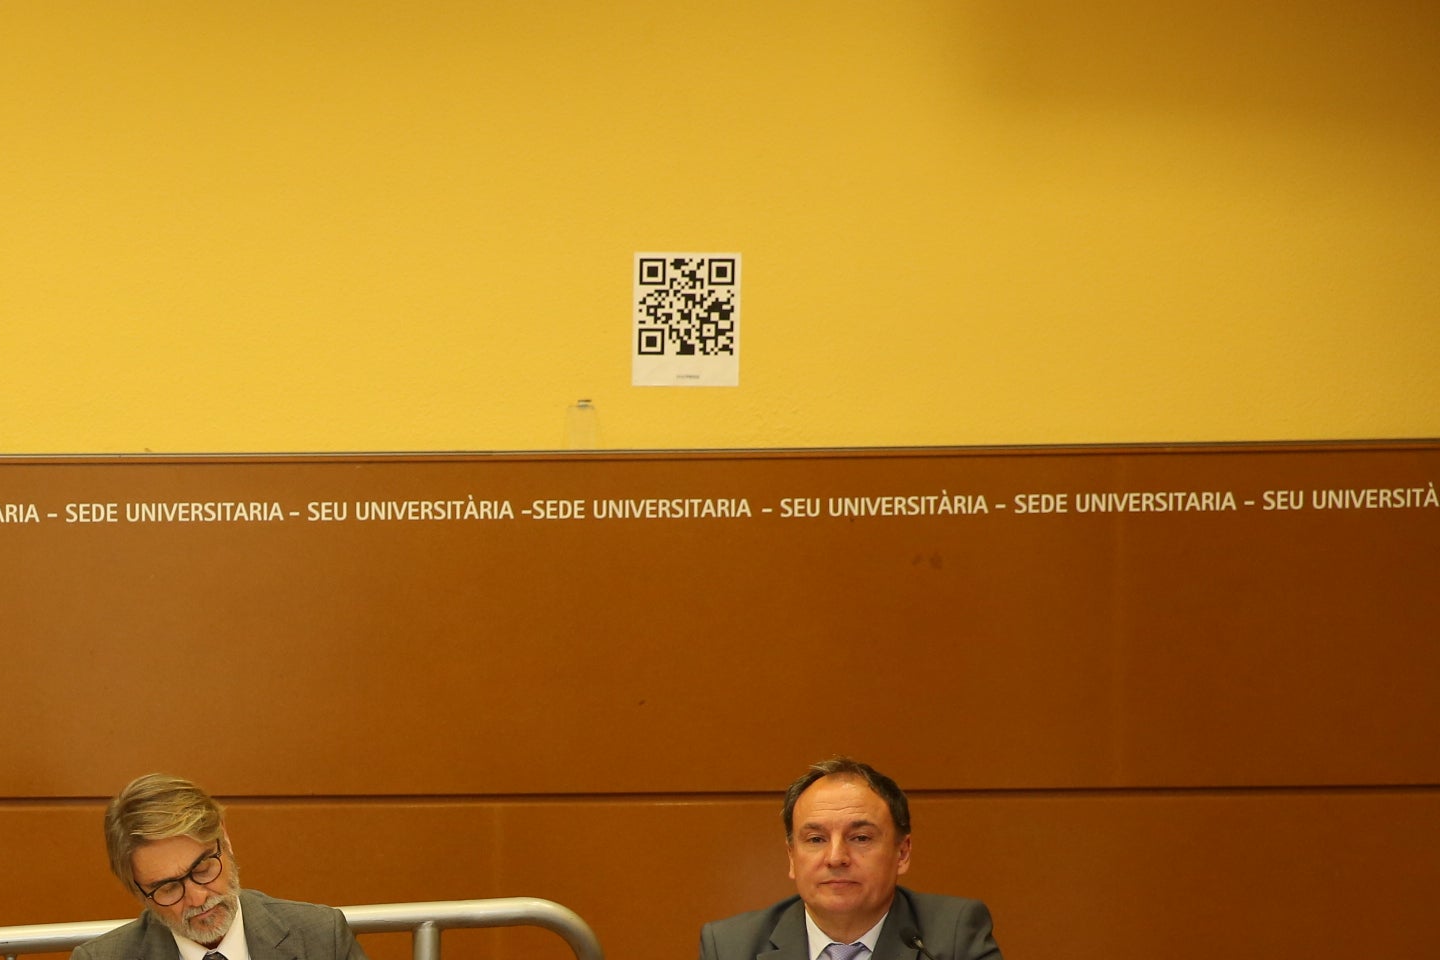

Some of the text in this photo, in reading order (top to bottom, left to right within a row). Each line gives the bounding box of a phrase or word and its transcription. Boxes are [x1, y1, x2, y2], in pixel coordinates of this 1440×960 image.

[65, 503, 118, 523] SEDE
[126, 502, 284, 522] UNIVERSITARIA
[307, 501, 347, 521] SEU
[355, 494, 514, 521] UNIVERSITÀRIA
[593, 498, 752, 519] UNIVERSITARIA
[780, 498, 820, 518] SEU
[828, 490, 988, 517] UNIVERSITÀRIA
[1014, 494, 1067, 514] SEDE
[1076, 492, 1236, 513] UNIVERSITARIA
[1263, 490, 1303, 510] SEU
